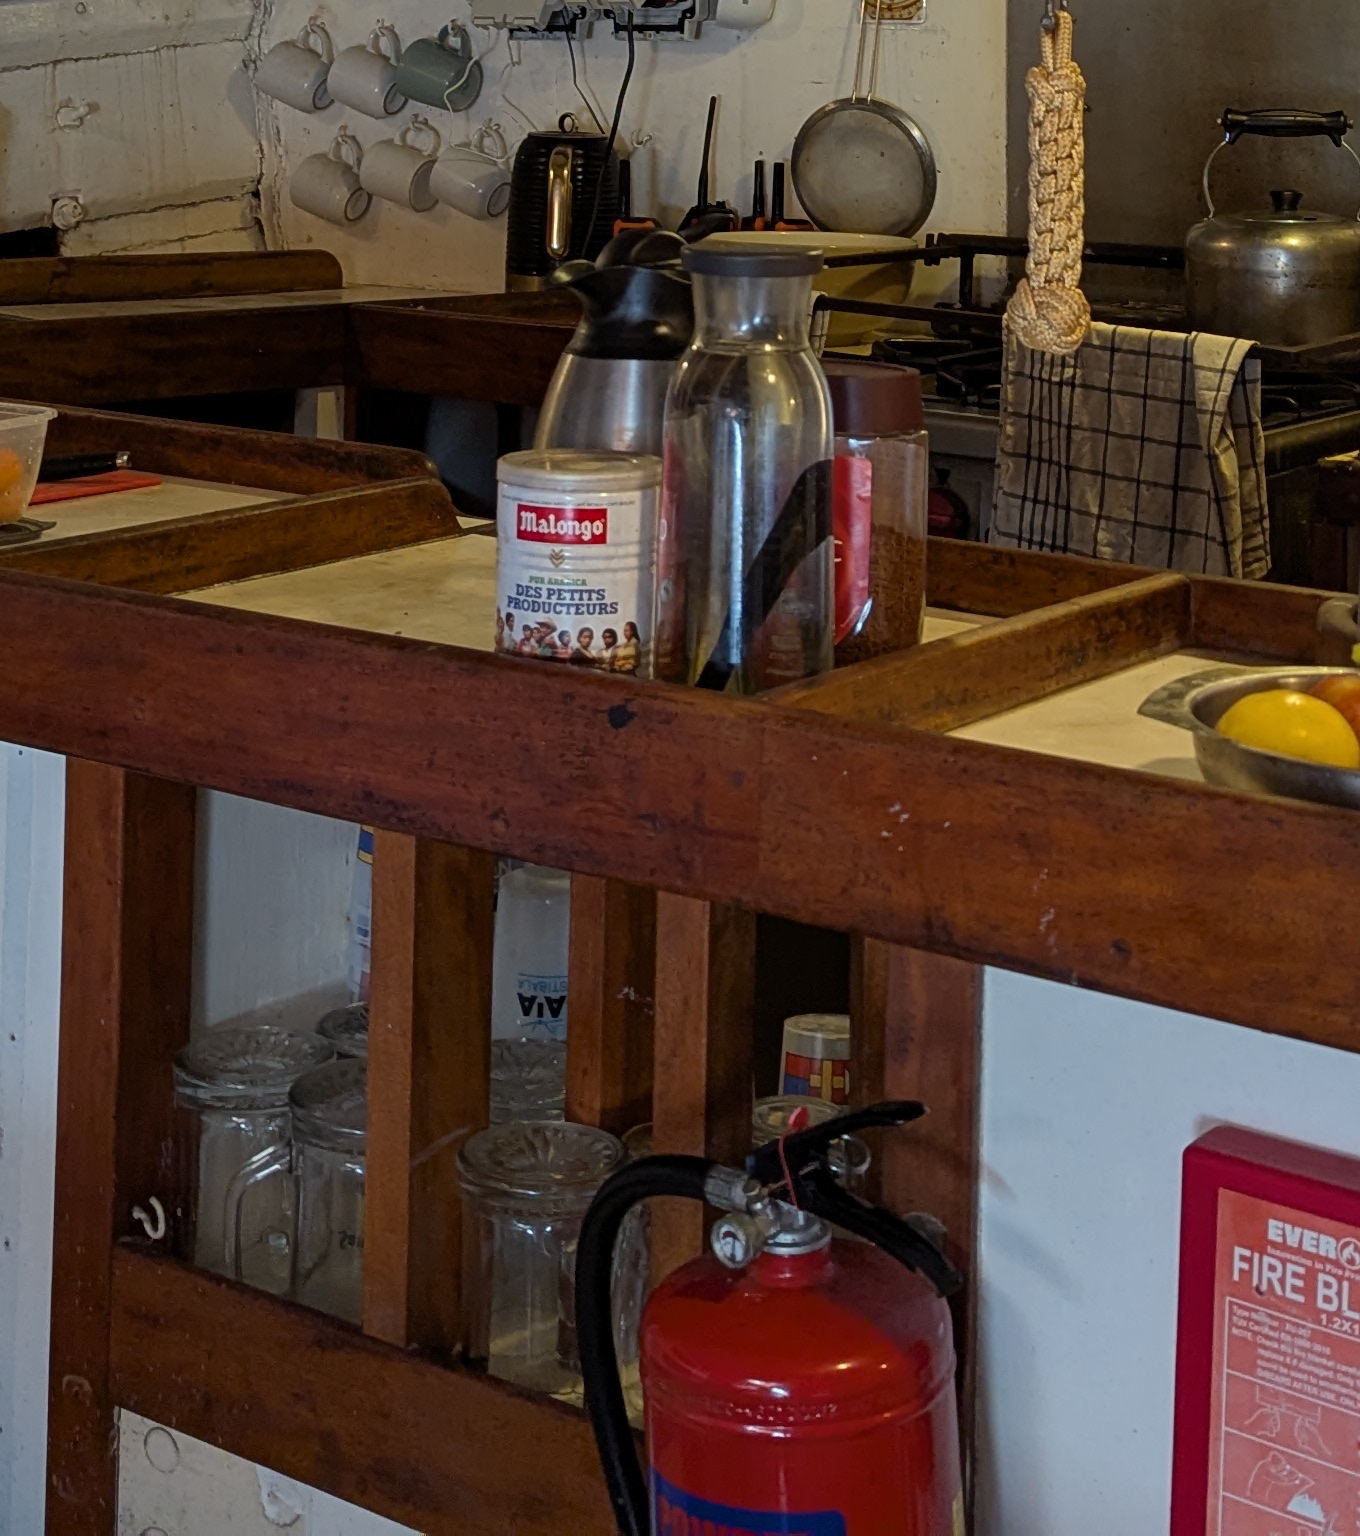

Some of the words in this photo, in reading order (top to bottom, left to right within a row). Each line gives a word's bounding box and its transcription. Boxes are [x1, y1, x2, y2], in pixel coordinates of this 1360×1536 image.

[520, 511, 604, 541] Malongo
[516, 584, 542, 599] DES
[546, 588, 606, 602] PETITS
[529, 575, 545, 584] PUR
[547, 577, 588, 586] ARABICA
[506, 595, 619, 616] PRODUCTEURS
[1268, 1218, 1338, 1260] EVER
[1232, 1245, 1306, 1303] FIRE
